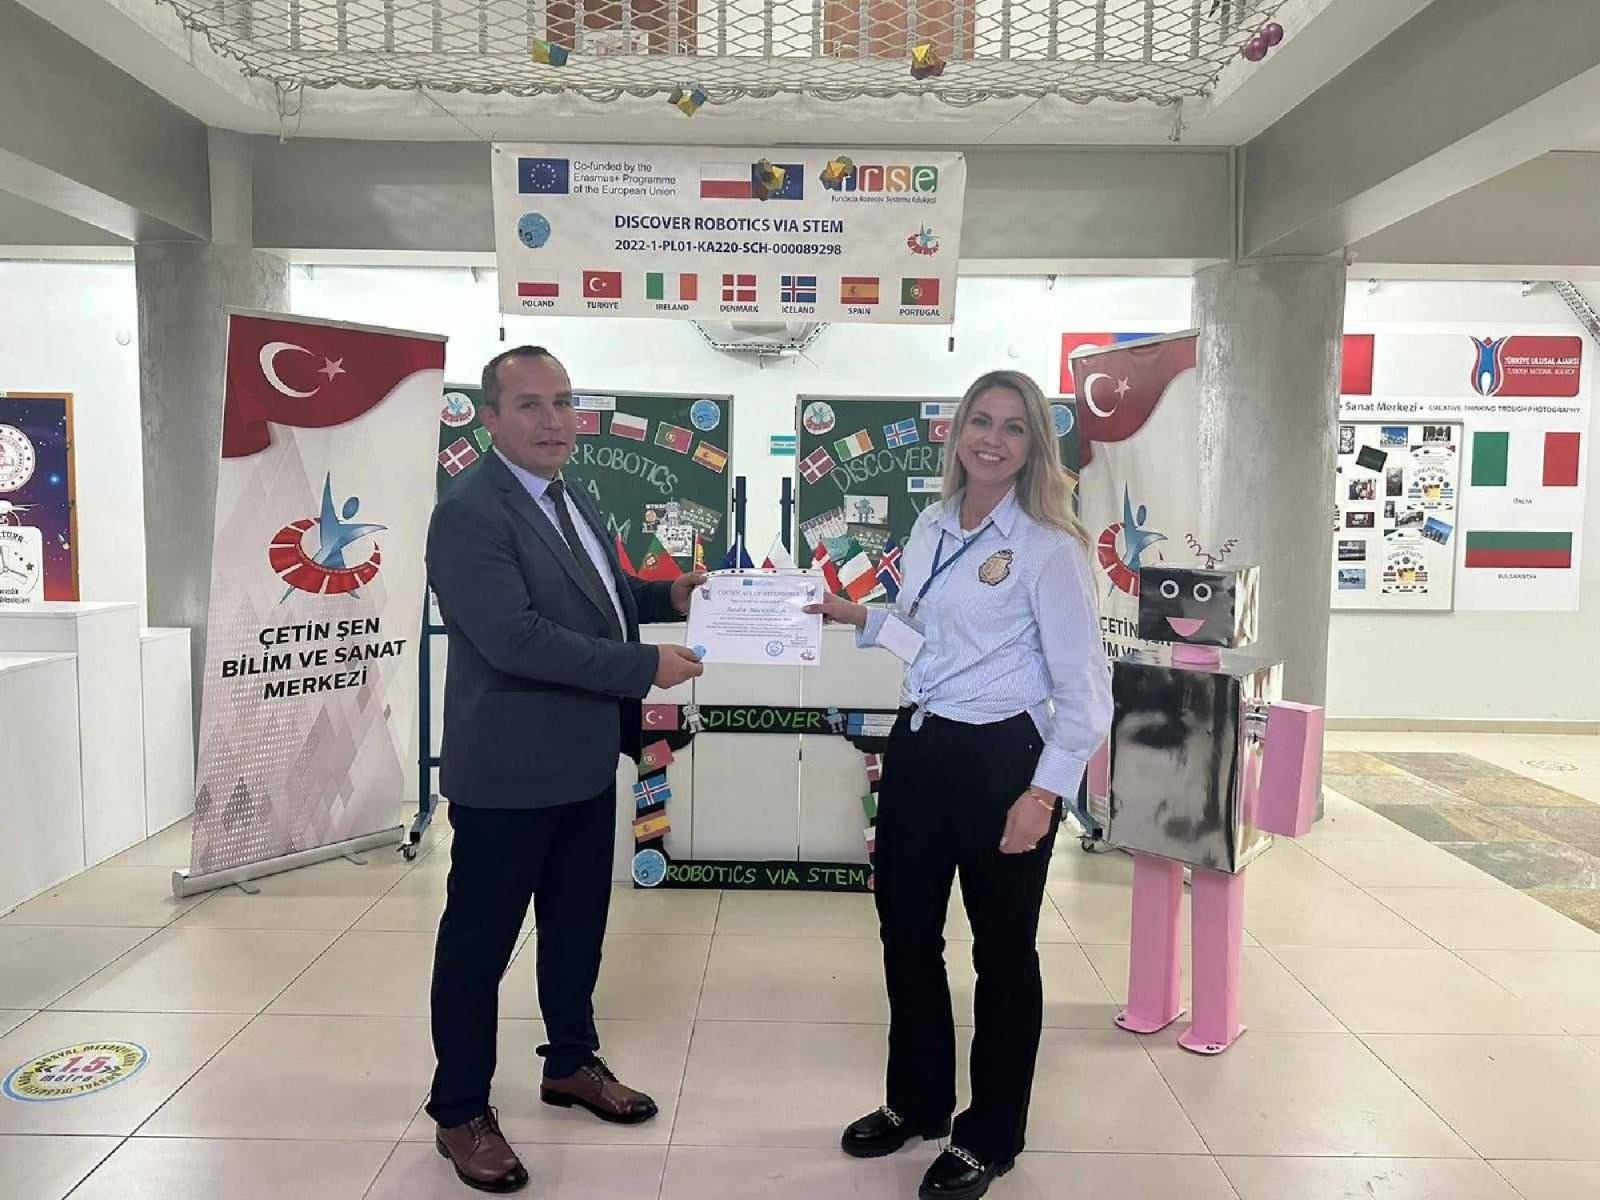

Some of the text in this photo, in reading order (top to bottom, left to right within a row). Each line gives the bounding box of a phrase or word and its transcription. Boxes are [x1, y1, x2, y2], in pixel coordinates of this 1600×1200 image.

[573, 160, 652, 173] Co-funded by the
[573, 173, 677, 185] Erasmus+ Programme
[573, 185, 677, 197] of the European Union
[615, 215, 843, 233] DISCOVER ROBOTICS VIA STEM
[615, 239, 842, 255] 2022-1-PL01-KA220-SCH-000089298
[522, 299, 555, 308] POLAND
[655, 303, 689, 311] IRELAND
[720, 304, 759, 313] DENMARK
[781, 306, 815, 314] ICELAND
[848, 307, 871, 316] SPAIN
[899, 308, 940, 317] PORTUGAL
[1345, 401, 1418, 412] Sanat Merkezi
[583, 446, 679, 494] ROBOTICS
[830, 445, 933, 494] DISCOVER
[259, 617, 380, 649] ÇETİN ŞEN
[222, 640, 407, 678] BİLİM VE SANAT
[263, 666, 368, 700] MERKEZİ
[709, 709, 821, 728] DISCOVER
[666, 864, 865, 886] ROBOTICS VIA STEM
